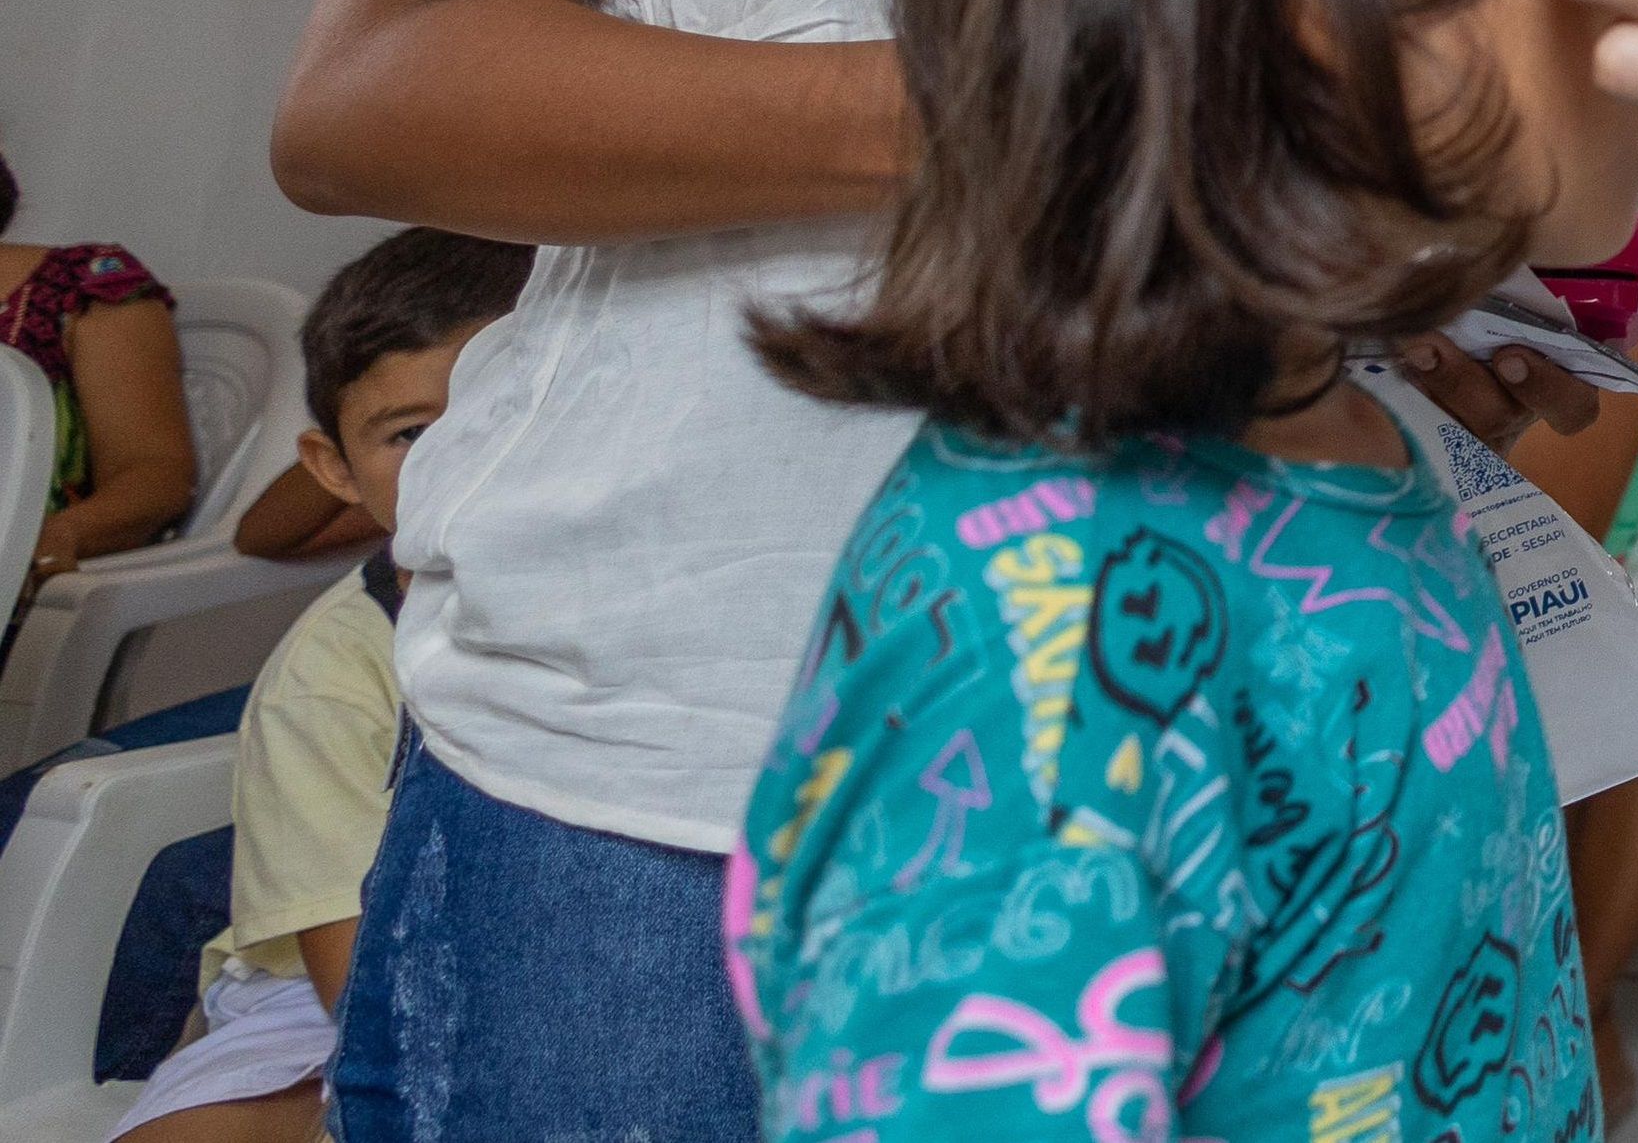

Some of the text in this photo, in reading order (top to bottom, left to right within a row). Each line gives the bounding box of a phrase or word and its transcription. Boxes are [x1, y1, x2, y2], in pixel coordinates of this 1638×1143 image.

[1481, 513, 1560, 548] SECRETARIA
[1521, 528, 1566, 552] SESAPI
[1507, 567, 1579, 600] GOVERNO DO
[1509, 577, 1590, 626] PIAUÍ
[1518, 602, 1593, 637] AQUI TEM TRABALHO
[1525, 614, 1592, 646] AQUI TEM FUTURO
